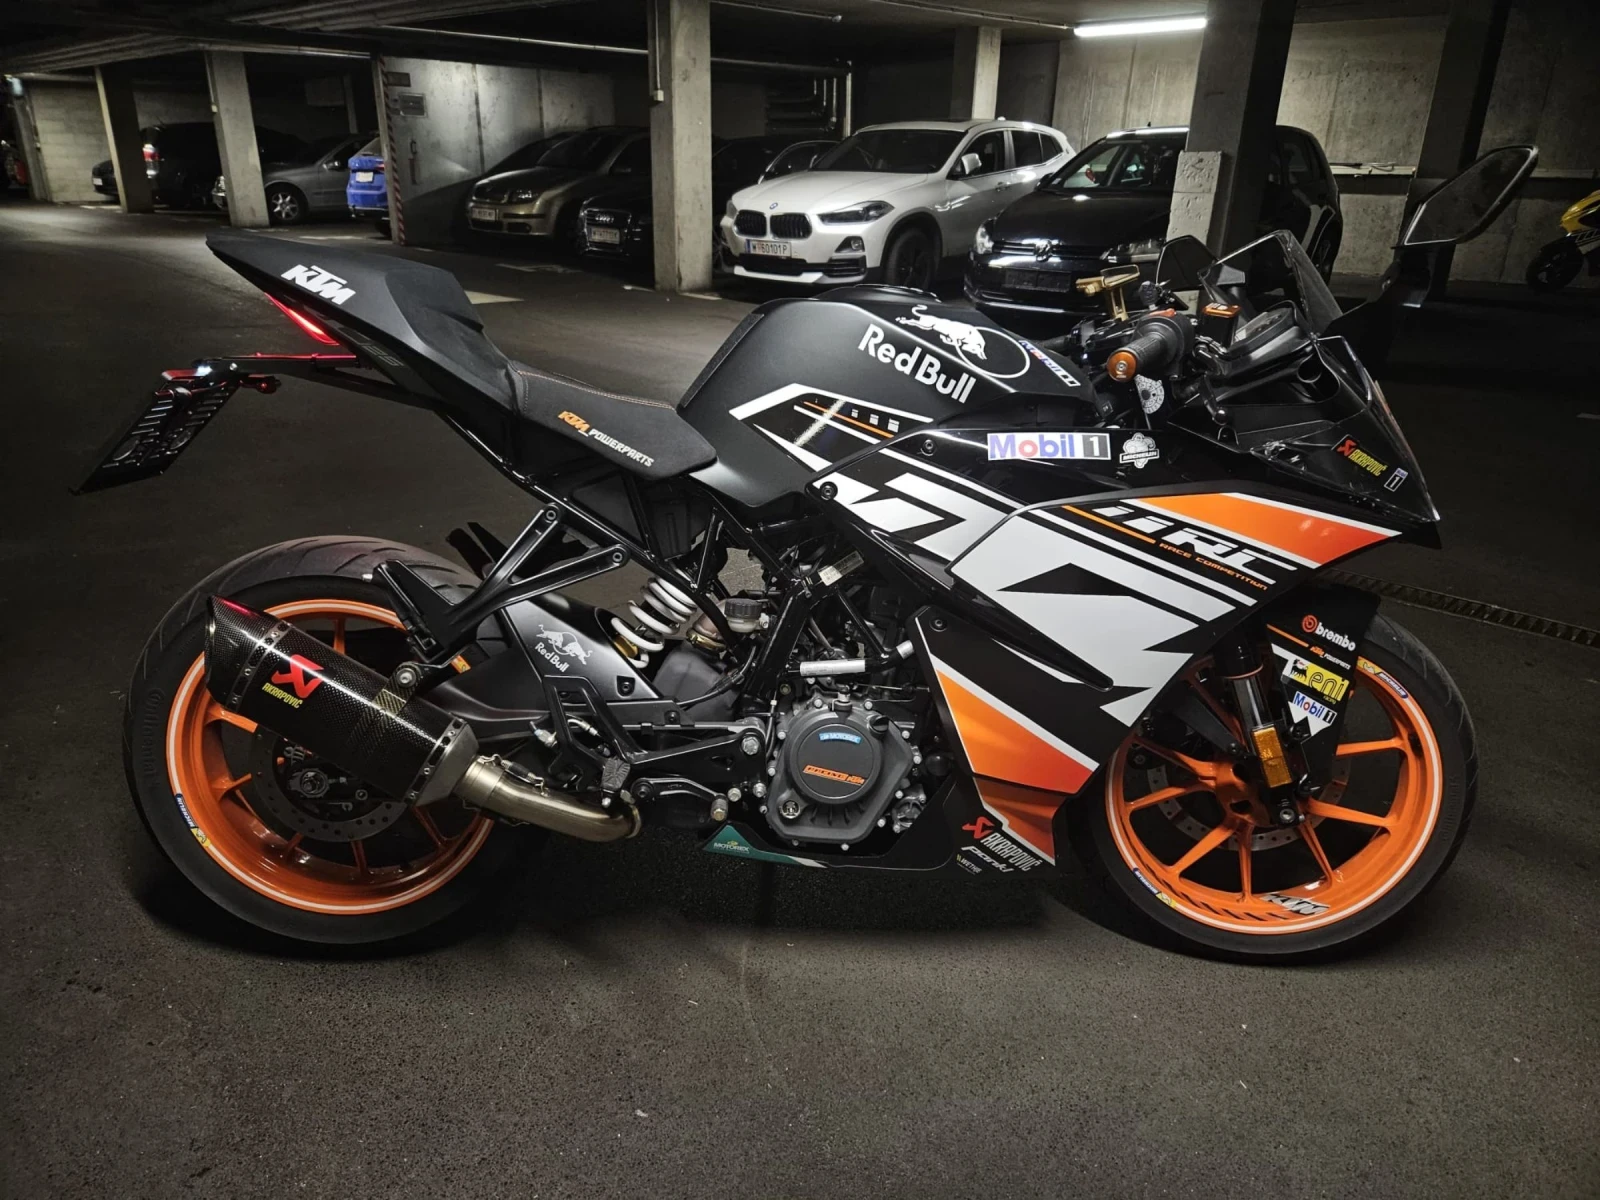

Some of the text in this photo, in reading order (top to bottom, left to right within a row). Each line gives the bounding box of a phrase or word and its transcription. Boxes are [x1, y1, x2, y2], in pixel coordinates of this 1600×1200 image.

[281, 264, 356, 305] KTM
[858, 323, 977, 404] Red Bull
[558, 411, 655, 467] KTM POWERPARTS
[989, 434, 1100, 459] Mobil 1
[1159, 542, 1268, 591] RACE COMPETITION
[1315, 622, 1356, 652] brembo
[535, 641, 570, 673] Red Bull
[1309, 671, 1345, 700] eni
[1292, 692, 1325, 719] Mobil
[714, 842, 749, 852] MOTOREX
